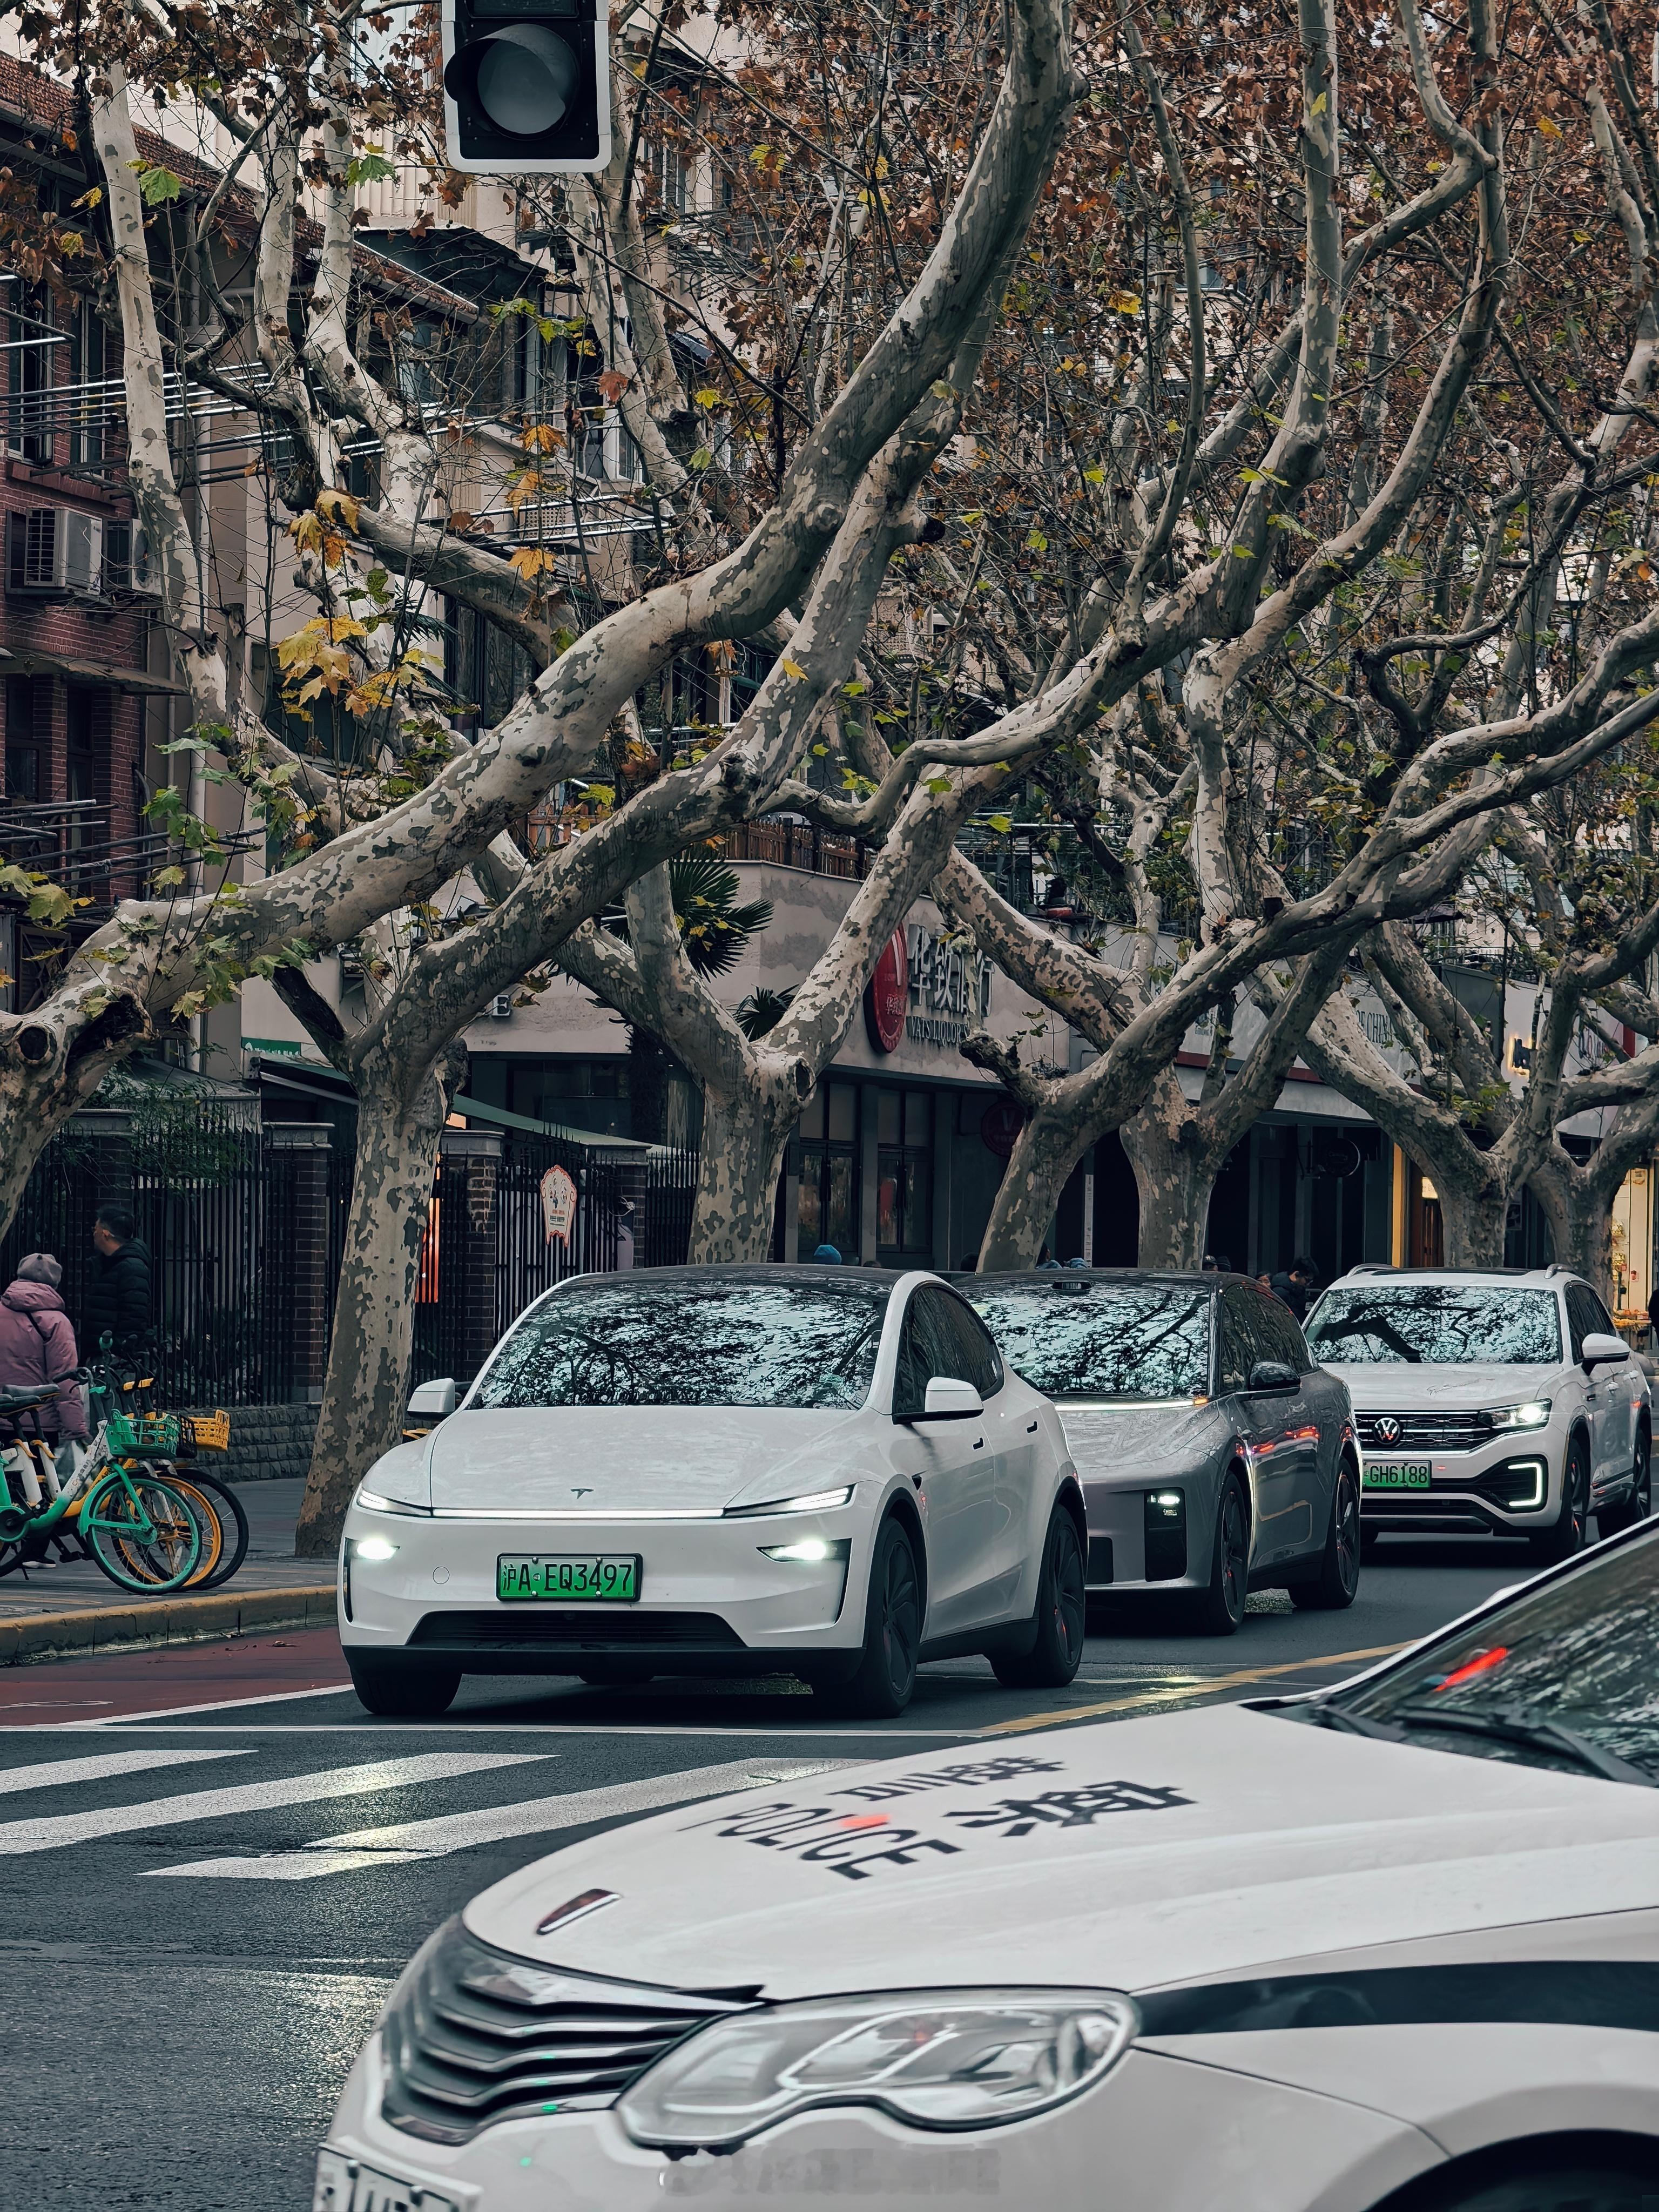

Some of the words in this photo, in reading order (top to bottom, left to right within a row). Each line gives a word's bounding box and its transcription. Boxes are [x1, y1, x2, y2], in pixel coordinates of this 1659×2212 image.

[911, 1016, 930, 1039] VATS
[933, 1020, 962, 1047] LIQUOR
[828, 1756, 1198, 1837] 警察
[676, 1803, 964, 1880] POLICE
